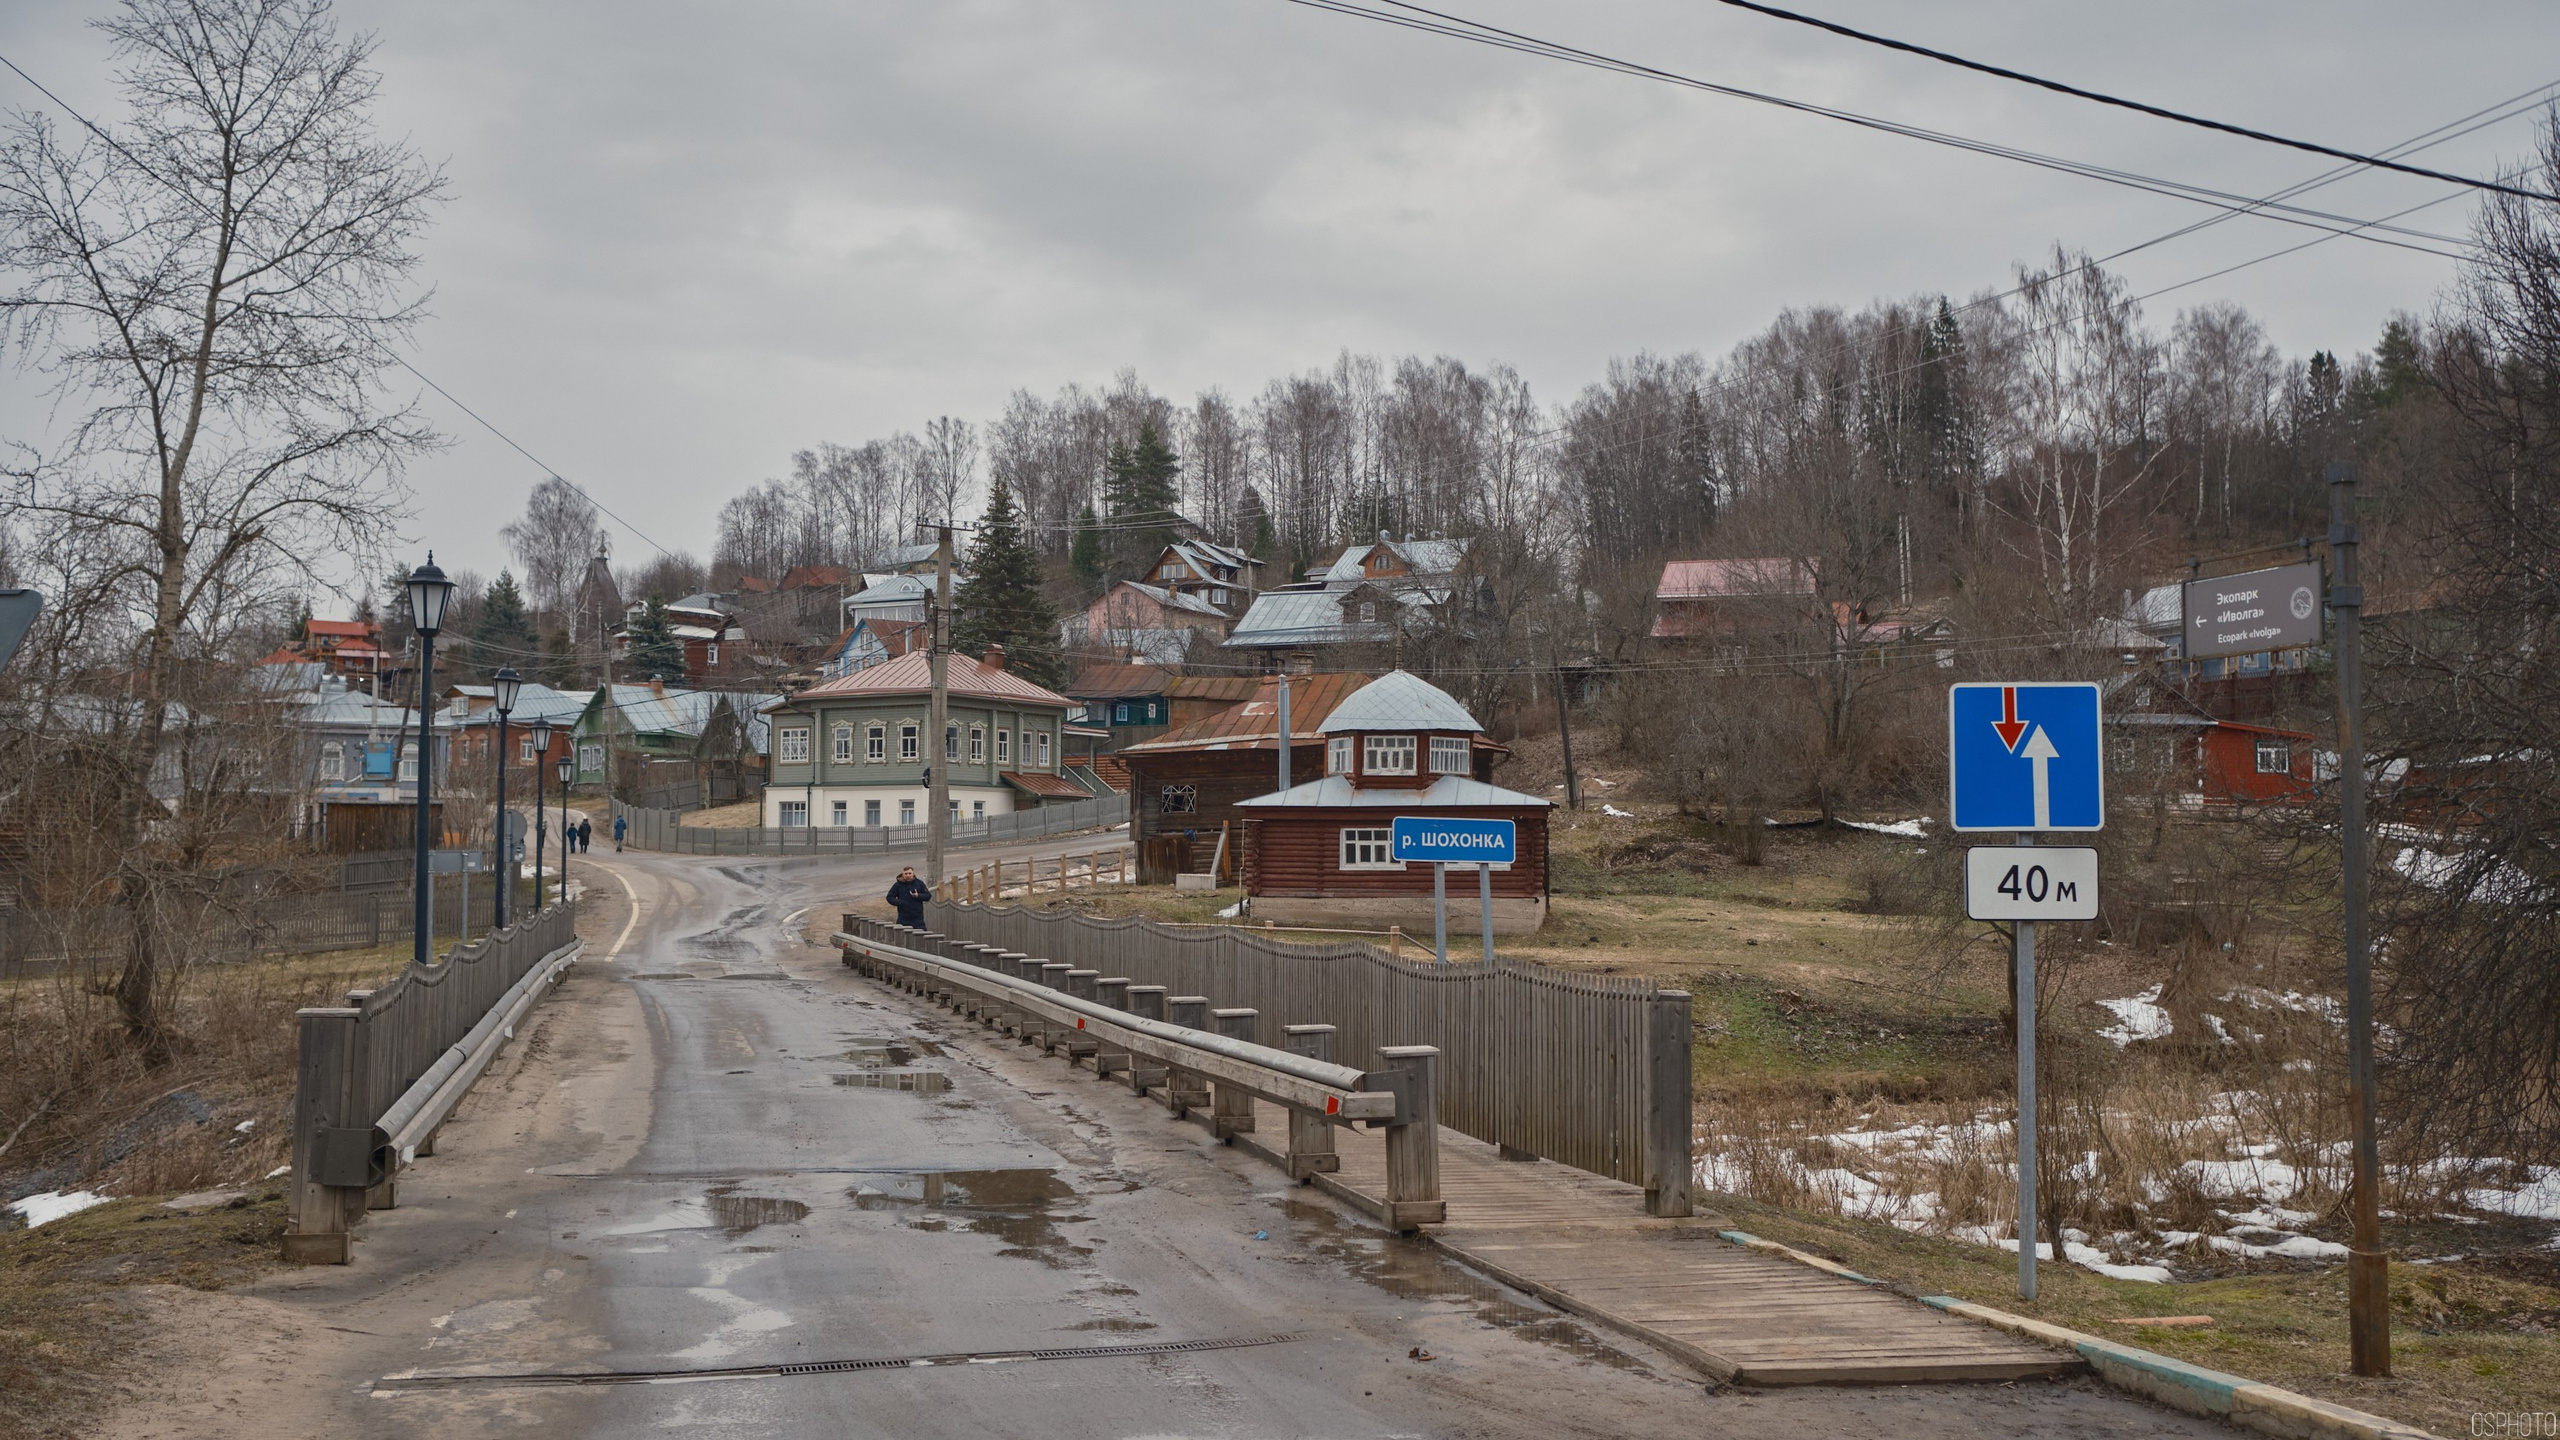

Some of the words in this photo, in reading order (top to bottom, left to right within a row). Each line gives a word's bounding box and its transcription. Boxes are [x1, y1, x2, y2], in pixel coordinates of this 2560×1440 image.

[2216, 589, 2259, 605] Экопарк
[2217, 608, 2265, 624] «Иволга»
[2217, 630, 2248, 644] Ecopark
[2249, 626, 2281, 640] «Ivolga»
[1402, 835, 1416, 849] р.
[1421, 832, 1505, 849] ШОХОНКА
[1997, 864, 2049, 903] 40
